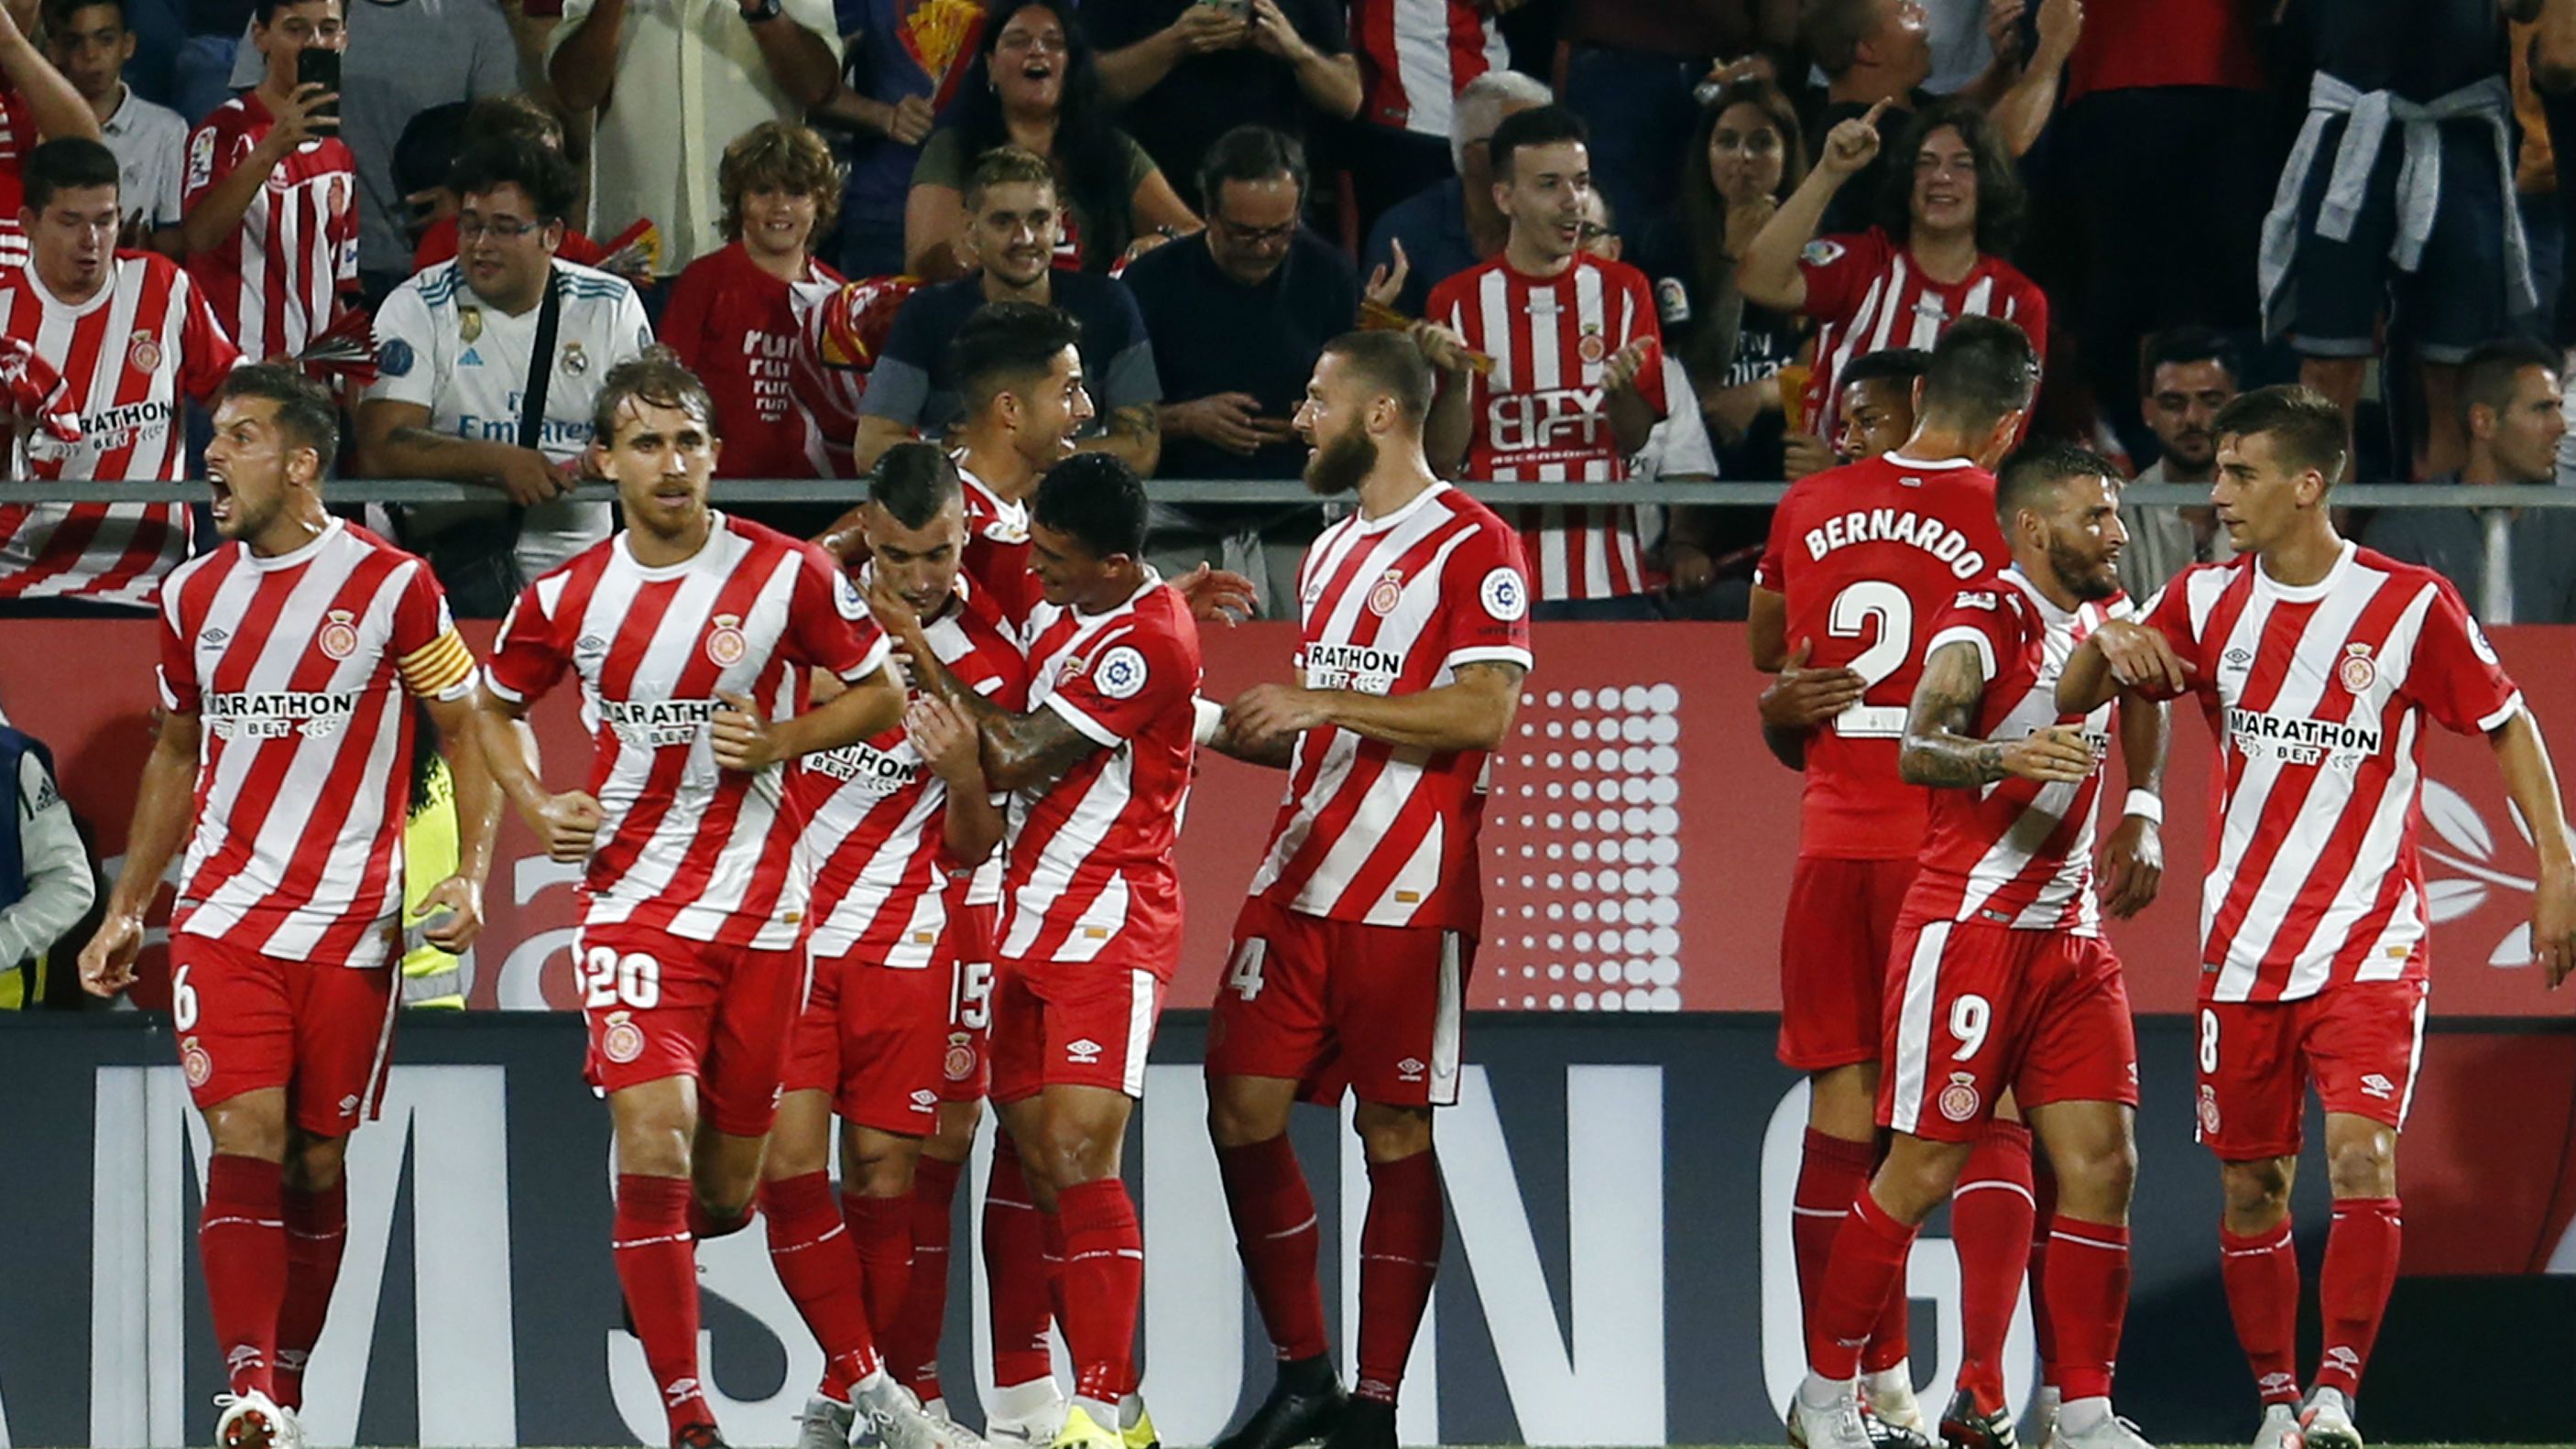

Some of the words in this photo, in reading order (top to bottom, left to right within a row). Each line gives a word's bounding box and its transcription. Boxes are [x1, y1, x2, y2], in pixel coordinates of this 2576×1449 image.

[80, 400, 174, 434] RATHON
[756, 398, 788, 410] run
[93, 434, 126, 451] BET
[1805, 509, 1984, 580] BERNARDO
[1311, 646, 1400, 674] RATHON
[1828, 580, 1913, 738] 2
[248, 722, 288, 735] BET
[649, 730, 693, 745] BET
[2231, 710, 2378, 750] MARATHON
[812, 756, 849, 777] BET
[2276, 746, 2318, 763] BET
[585, 946, 660, 1009] 20
[1229, 936, 1267, 1001] 4
[172, 964, 199, 1032] 6
[949, 959, 994, 1029] 15
[1948, 994, 1992, 1062] 9
[2199, 1008, 2220, 1074] 8
